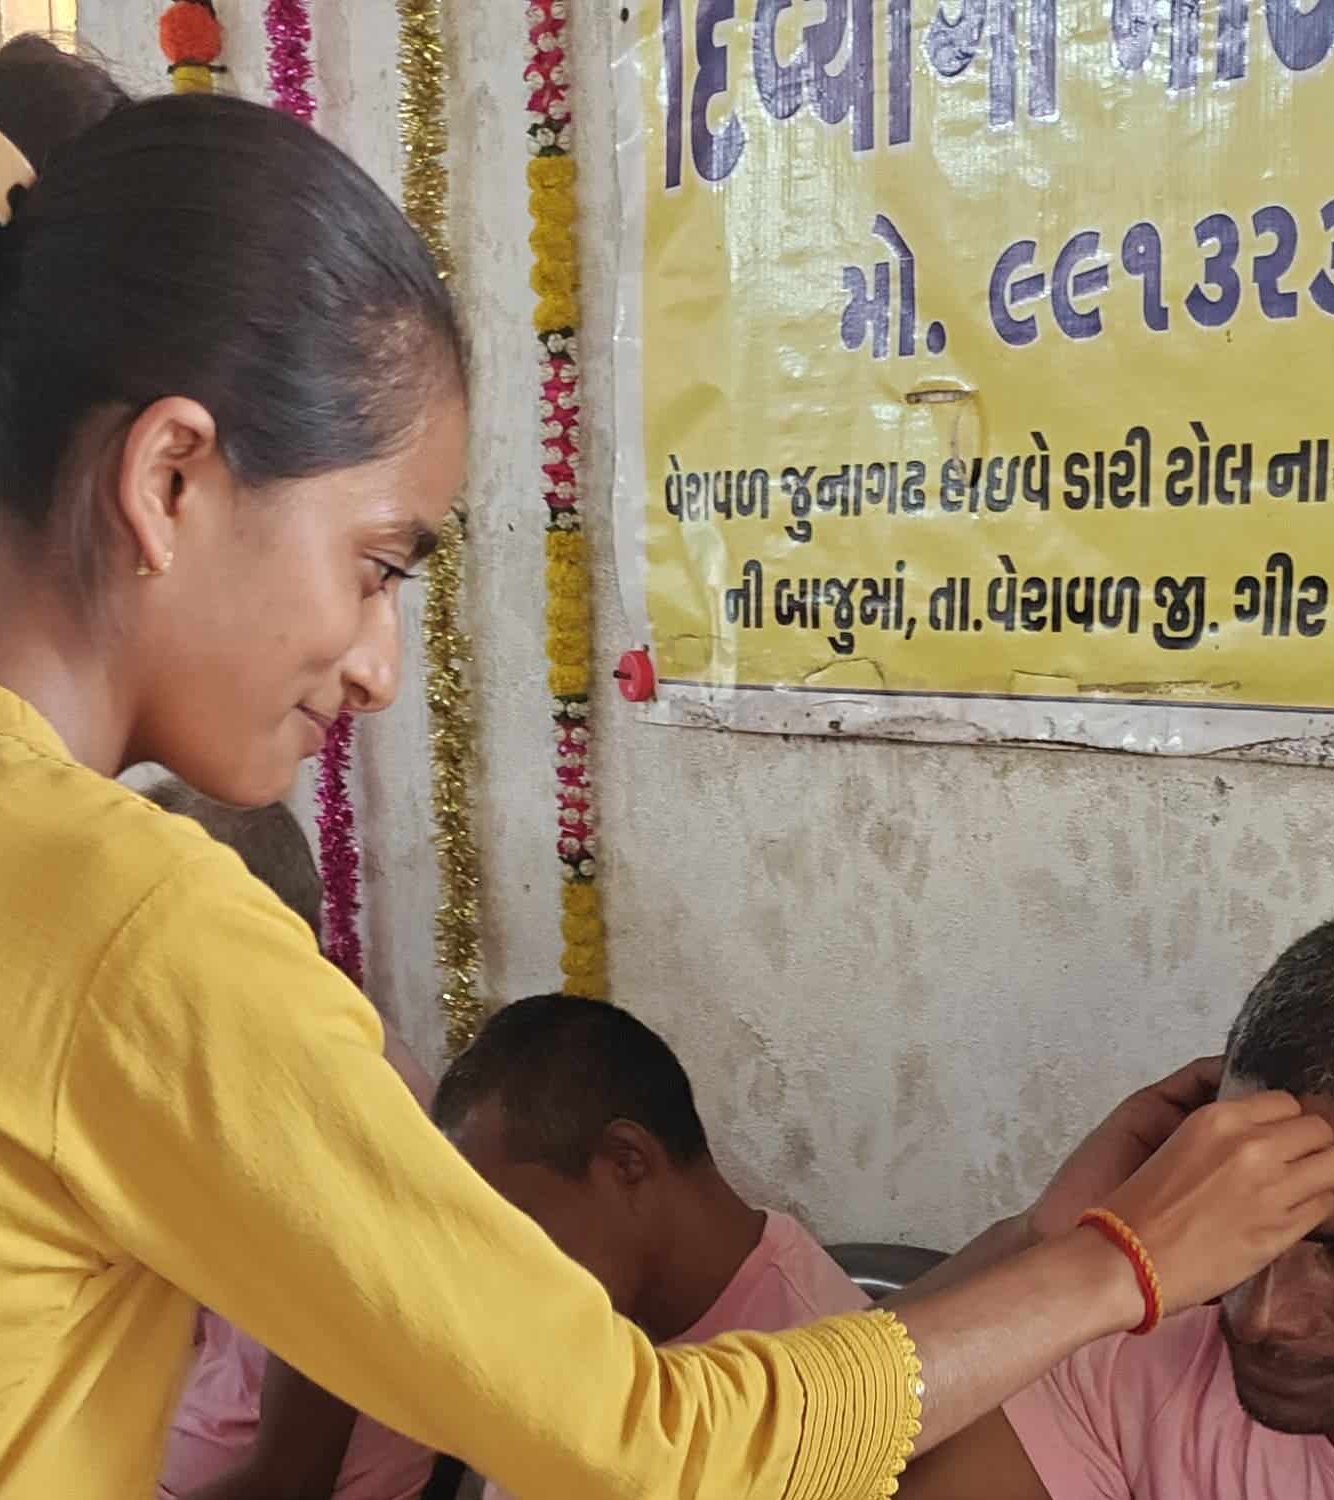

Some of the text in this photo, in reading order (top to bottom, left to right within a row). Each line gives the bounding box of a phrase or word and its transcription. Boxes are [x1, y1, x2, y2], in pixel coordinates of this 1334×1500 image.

[842, 214, 946, 359] મો.
[665, 454, 769, 522] વેરાવળ
[780, 460, 927, 543] જુનાગઢ
[1063, 426, 1151, 510] ડારી
[1166, 421, 1253, 507] ટોલ
[725, 559, 763, 629] ની
[775, 560, 917, 655] બાજુમાં,
[1153, 575, 1219, 651] જી.
[1234, 552, 1329, 638] ગીર
